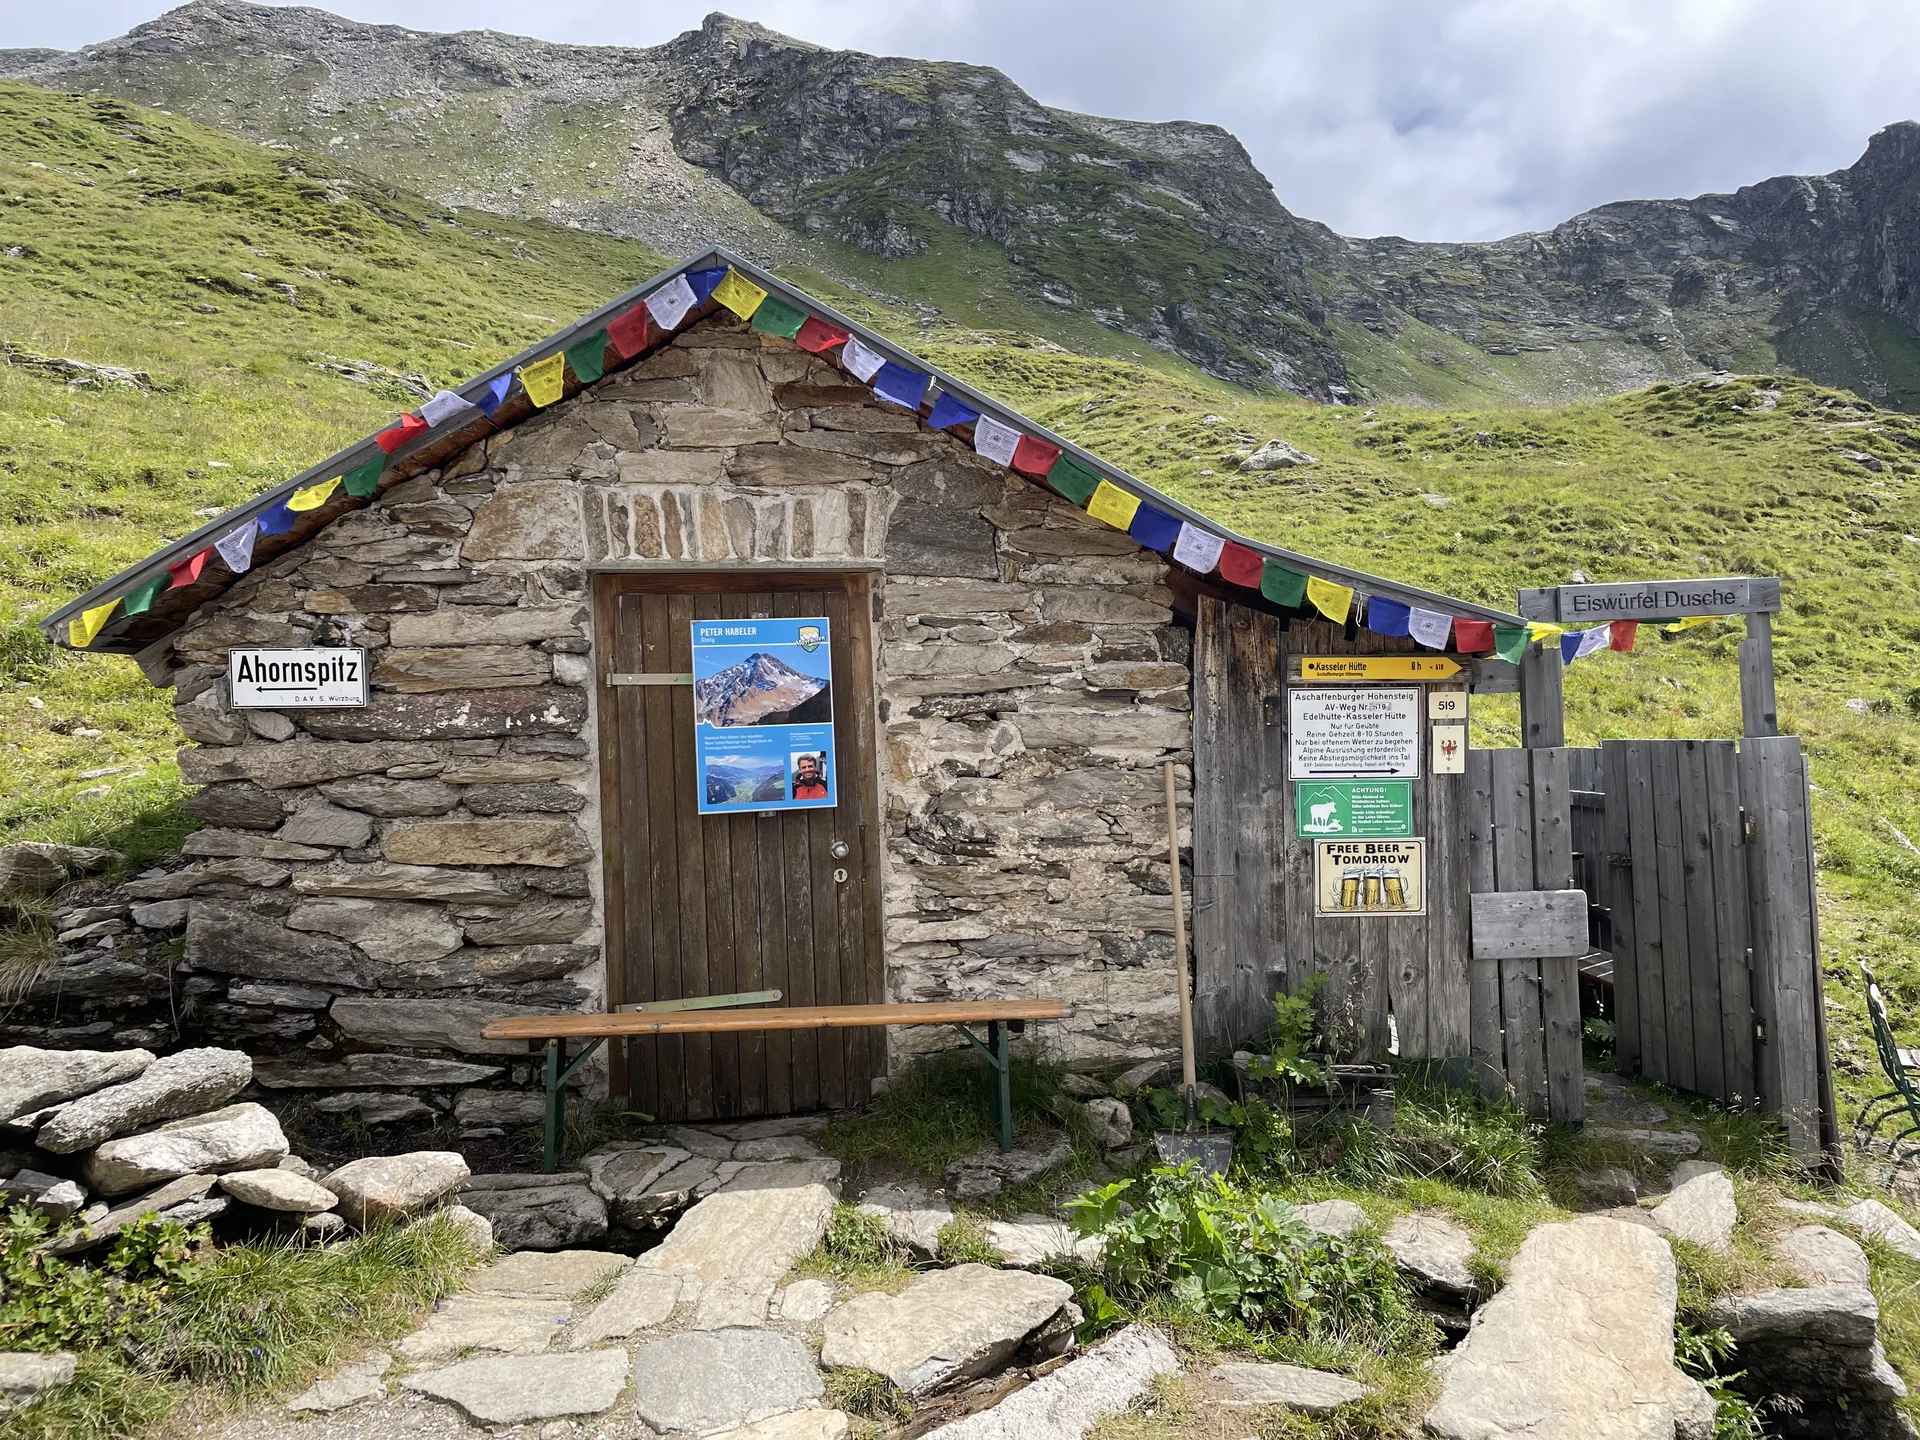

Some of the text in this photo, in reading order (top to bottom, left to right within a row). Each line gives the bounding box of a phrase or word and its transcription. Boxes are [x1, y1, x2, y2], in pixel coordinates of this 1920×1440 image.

[1573, 589, 1736, 612] Eiswürfel Dusche
[700, 626, 757, 637] PETER HABELER
[237, 655, 358, 686] Ahornspitz
[1316, 661, 1347, 671] Kasseler
[1348, 661, 1367, 671] Hütte
[328, 695, 360, 703] Würzburg
[1295, 692, 1414, 702] Aschaffenburger Höhensteig
[1324, 703, 1357, 712] AV-Weg
[1438, 700, 1455, 710] 519
[1303, 712, 1407, 721] Edelhütte-Kasseler Hütte
[1328, 730, 1355, 738] Gehzeit
[1385, 738, 1413, 747] begehen
[1303, 747, 1324, 755] Alpine
[1326, 746, 1365, 755] Ausrüstung
[1319, 754, 1387, 763] Abstiegsmöglichkeit
[1400, 753, 1410, 761] Tal
[1326, 844, 1359, 854] FREE
[1365, 844, 1400, 854] BEER
[1332, 854, 1410, 865] TOMORROW
